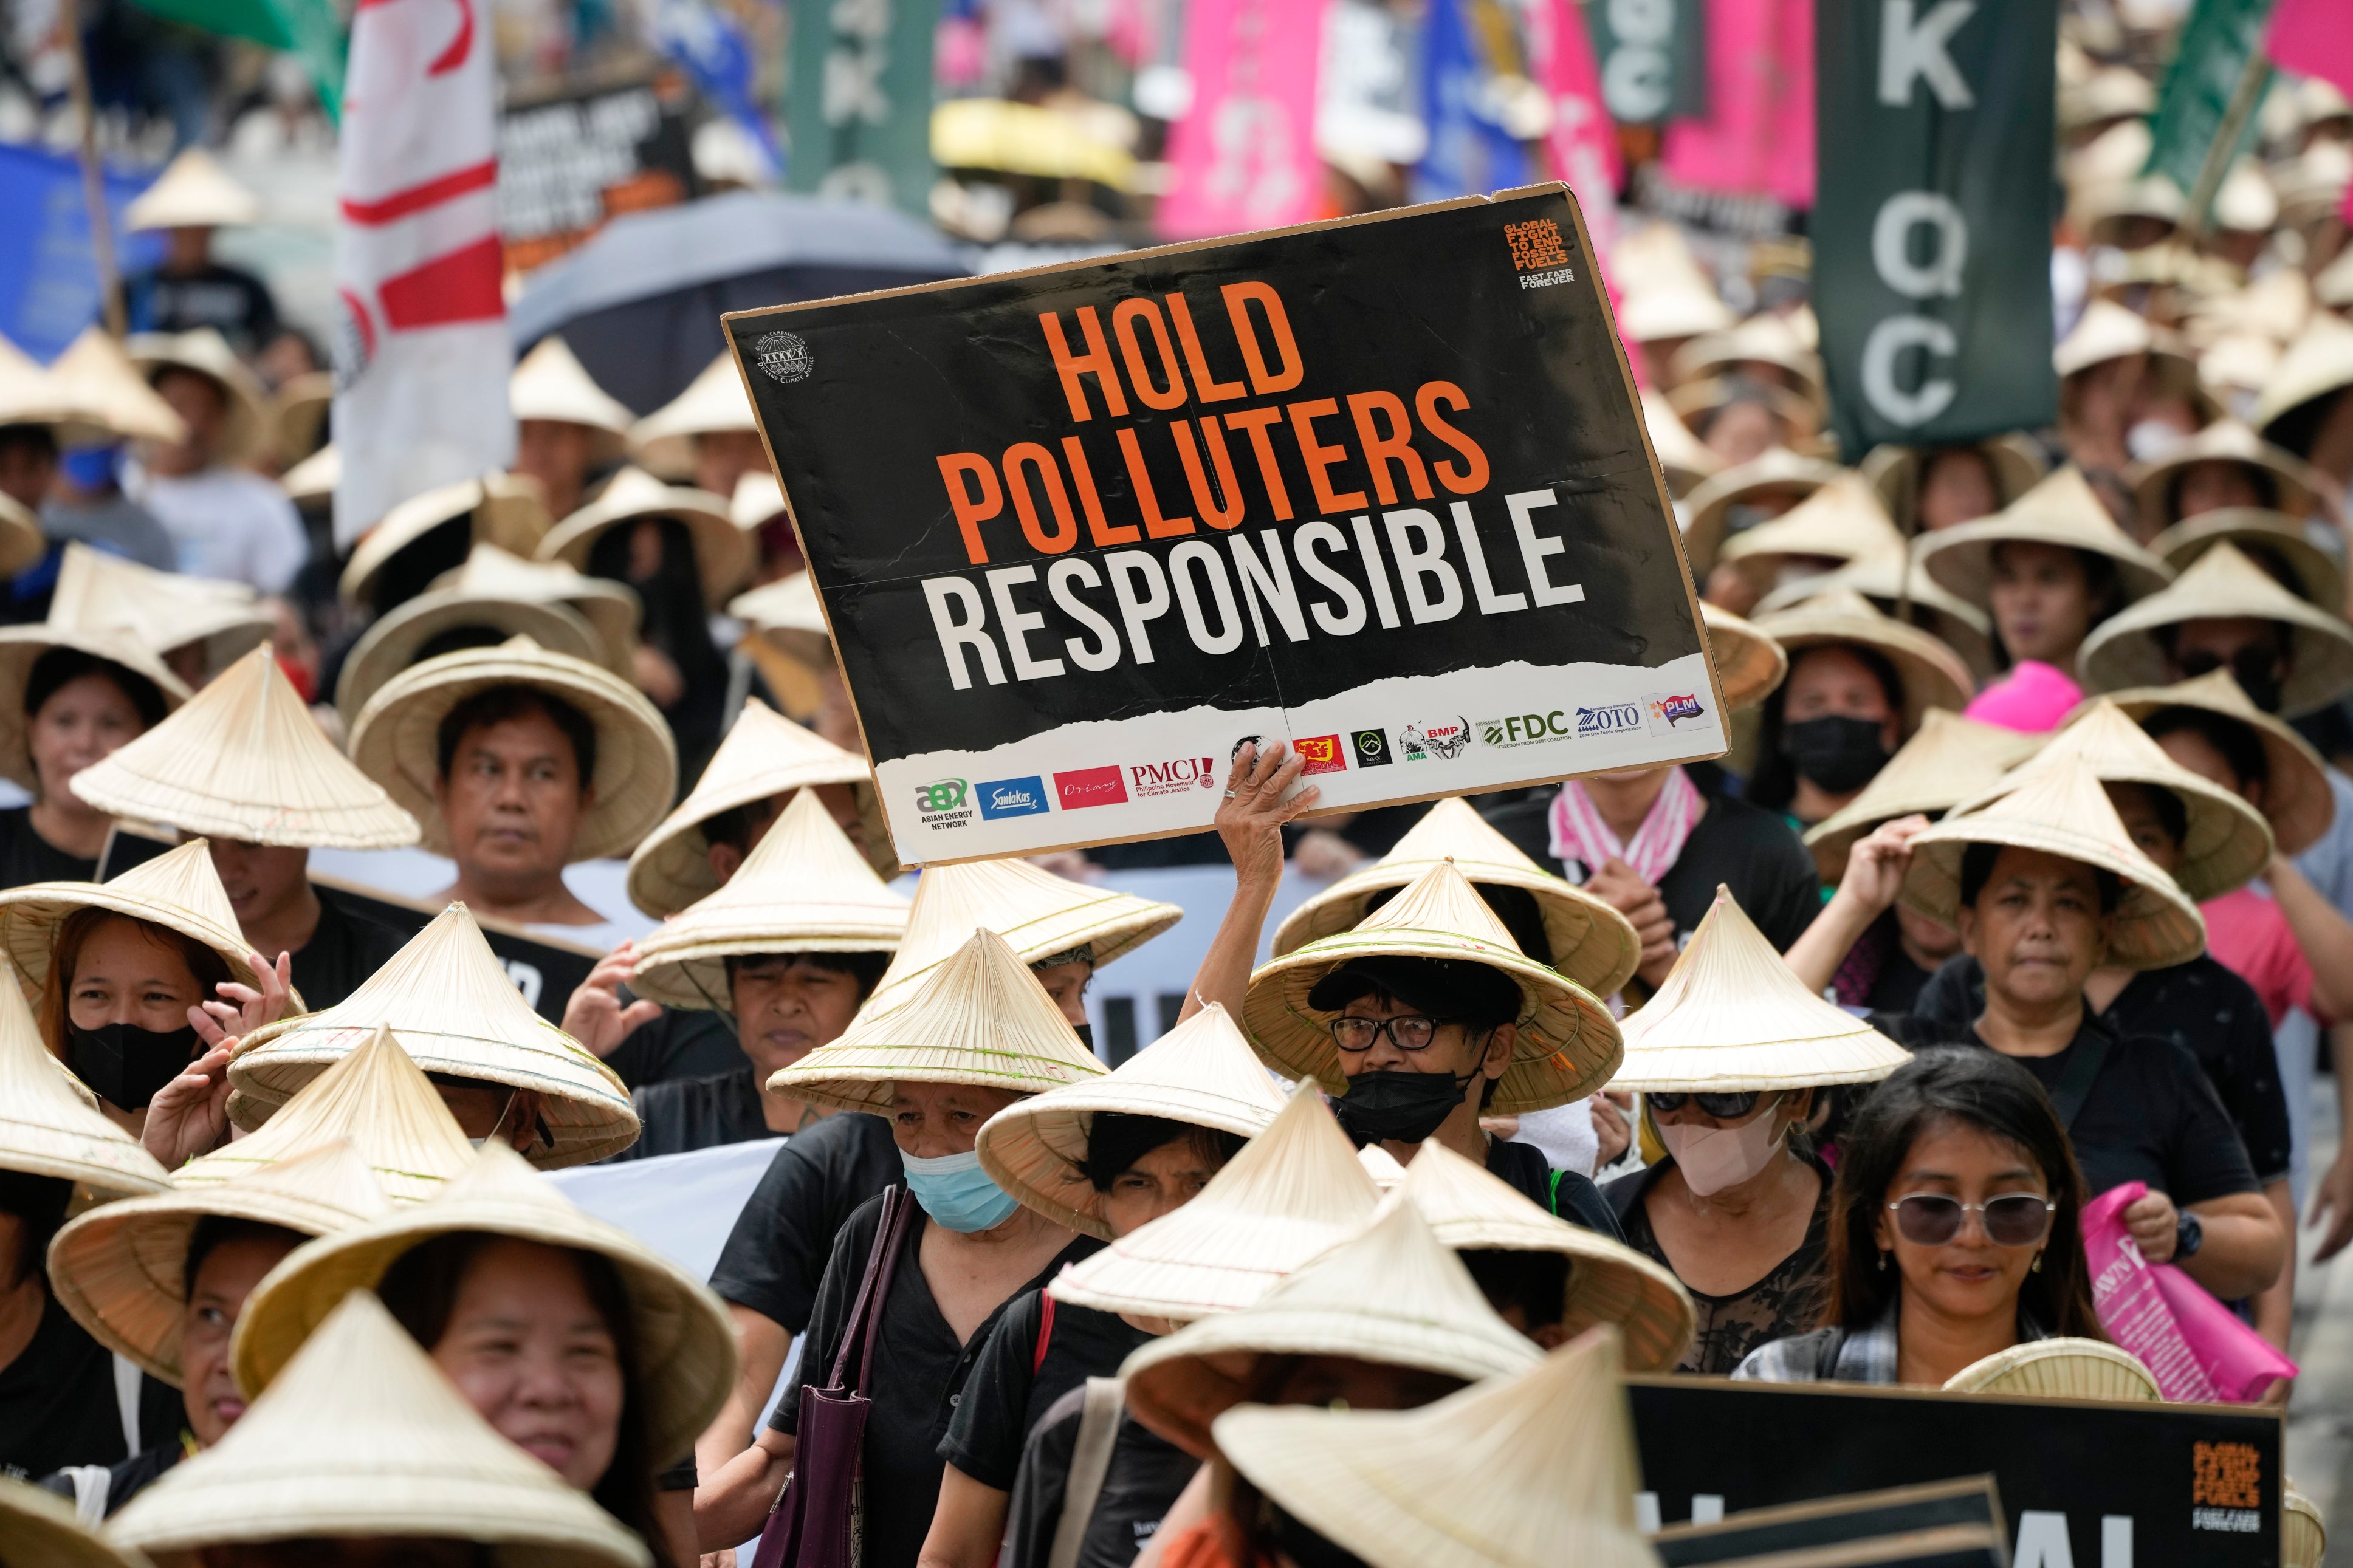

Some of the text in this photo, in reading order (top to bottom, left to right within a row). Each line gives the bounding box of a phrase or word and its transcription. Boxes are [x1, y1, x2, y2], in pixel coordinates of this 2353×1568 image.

[1503, 218, 1557, 233] GLOBAL
[1506, 225, 1558, 244] FIGHT
[1509, 235, 1562, 252] TO END
[1511, 245, 1565, 261] FOSSIL
[1514, 253, 1568, 271] FUELS
[1519, 268, 1573, 283] FAST FAIR
[1521, 275, 1575, 290] FOREVER
[755, 335, 769, 351] GLOBAL
[769, 330, 797, 340] CAMPAIGN
[1038, 281, 1305, 423] HOLD
[757, 356, 814, 383] DEMAND CLIMATE JUSTICE
[935, 380, 1491, 566] POLLUTERS
[920, 488, 1585, 691] RESPONSIBLE
[1666, 698, 1696, 713] PLM
[1427, 726, 1458, 738] BMP
[1505, 711, 1569, 742] FDC
[1407, 752, 1427, 762] AMA
[1136, 780, 1195, 792] Philippine Movement
[991, 787, 1031, 810] Sanlakas
[921, 810, 973, 823] ASIAN ENERGY
[931, 820, 968, 831] NETWORK
